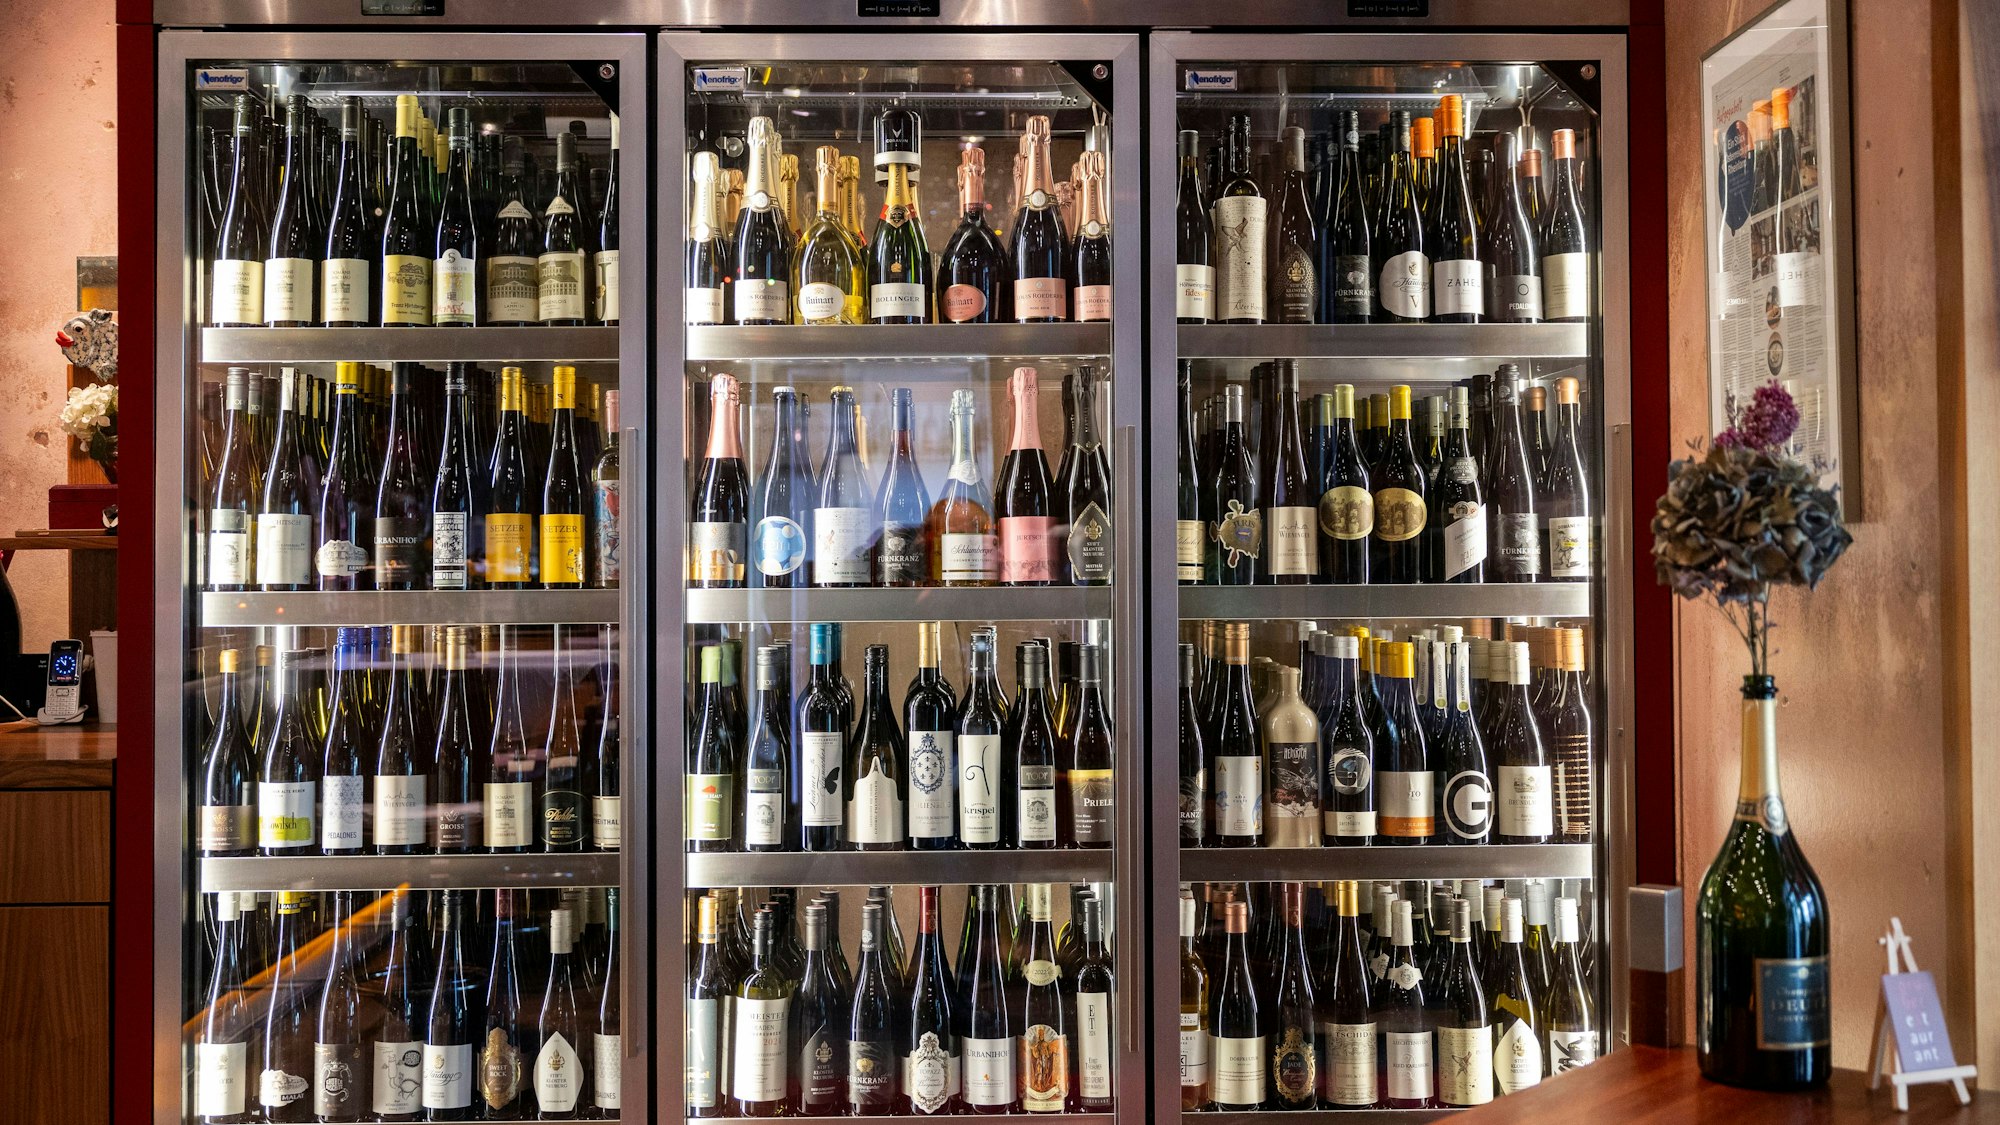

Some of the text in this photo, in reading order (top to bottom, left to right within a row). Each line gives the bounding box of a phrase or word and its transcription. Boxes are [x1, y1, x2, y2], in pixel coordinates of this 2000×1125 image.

[209, 75, 244, 84] enofrigo
[707, 76, 741, 84] enofrigo
[1199, 75, 1233, 84] enofrigo
[805, 296, 834, 306] Ruinart
[1508, 302, 1537, 310] PEDALO
[490, 524, 525, 532] SETZER
[1233, 520, 1256, 528] JURIS
[951, 544, 994, 556] Schlumberger
[442, 572, 454, 580] OTT
[1026, 772, 1048, 780] TOPF
[1084, 798, 1112, 806] PRIELE
[964, 806, 994, 815] krispel
[750, 1012, 785, 1020] MEISTER
[1910, 1031, 1934, 1046] aur
[1914, 1047, 1939, 1062] ant
[282, 1093, 304, 1101] MALAT
